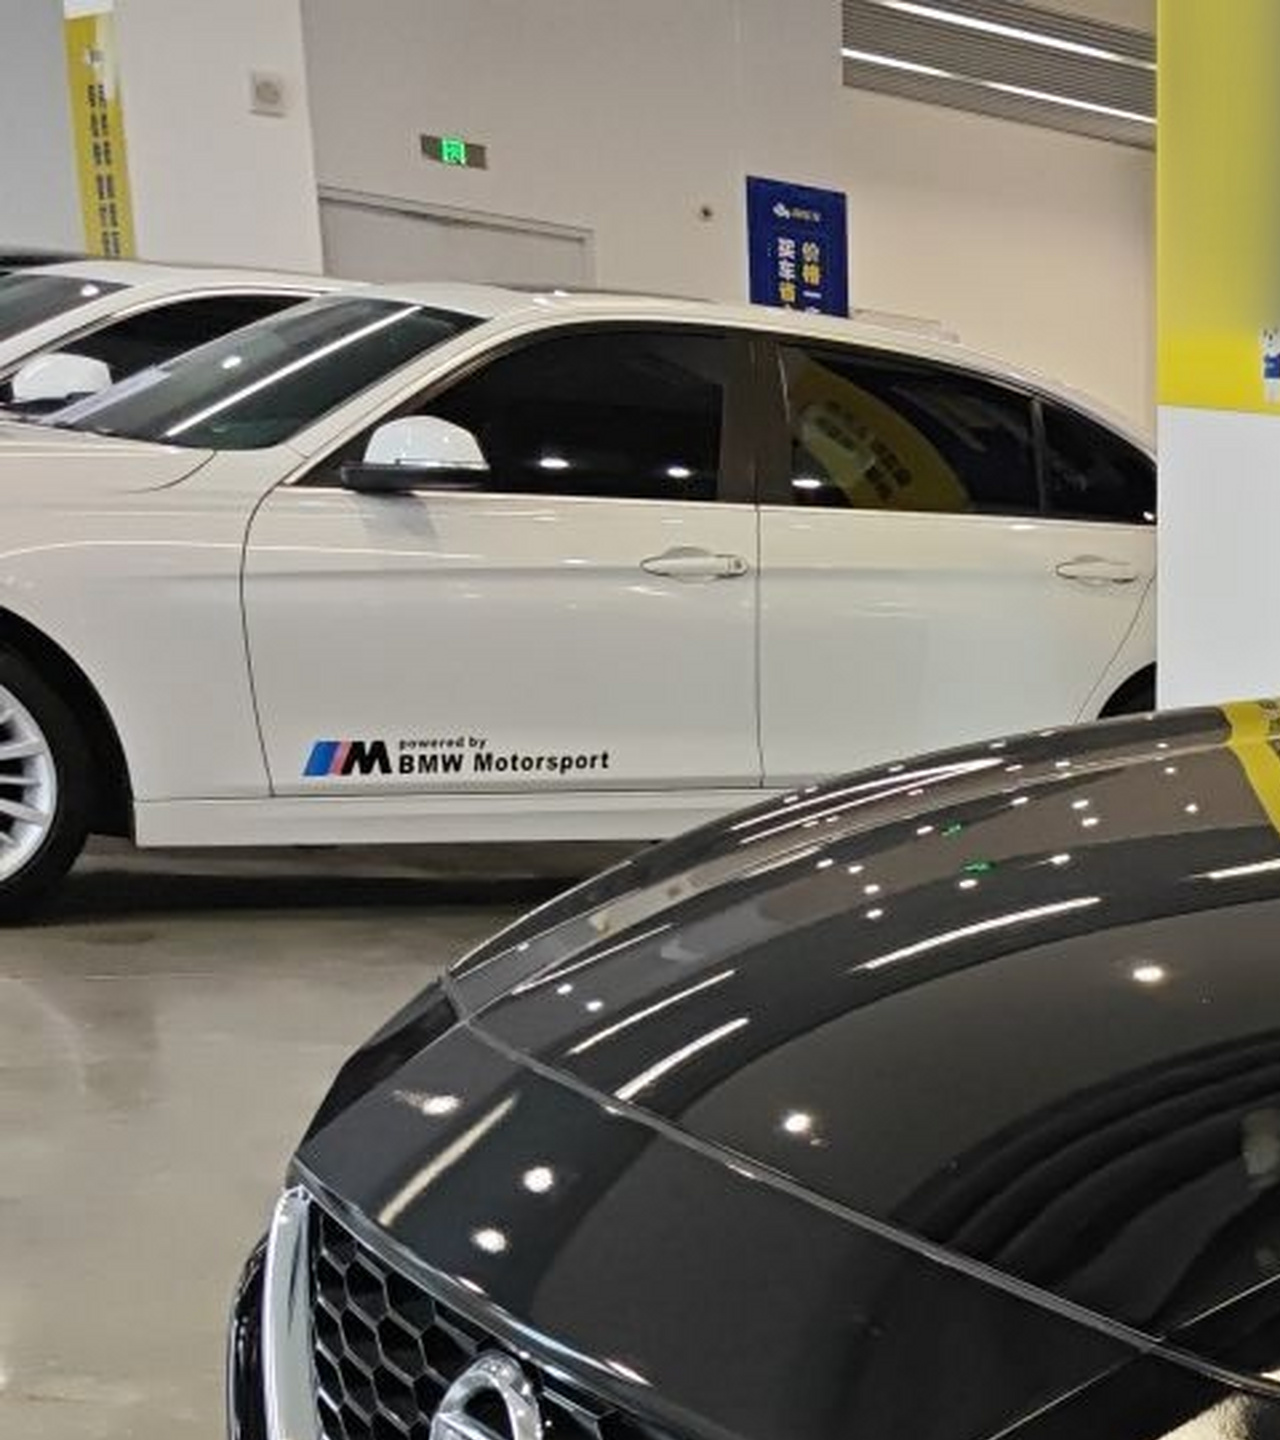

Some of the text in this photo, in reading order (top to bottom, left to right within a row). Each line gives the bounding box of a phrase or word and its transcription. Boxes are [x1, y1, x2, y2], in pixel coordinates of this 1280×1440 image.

[777, 237, 796, 309] 买车省
[802, 241, 822, 313] 价格一
[399, 752, 610, 775] BMW Motorsport
[400, 736, 487, 750] powered by
